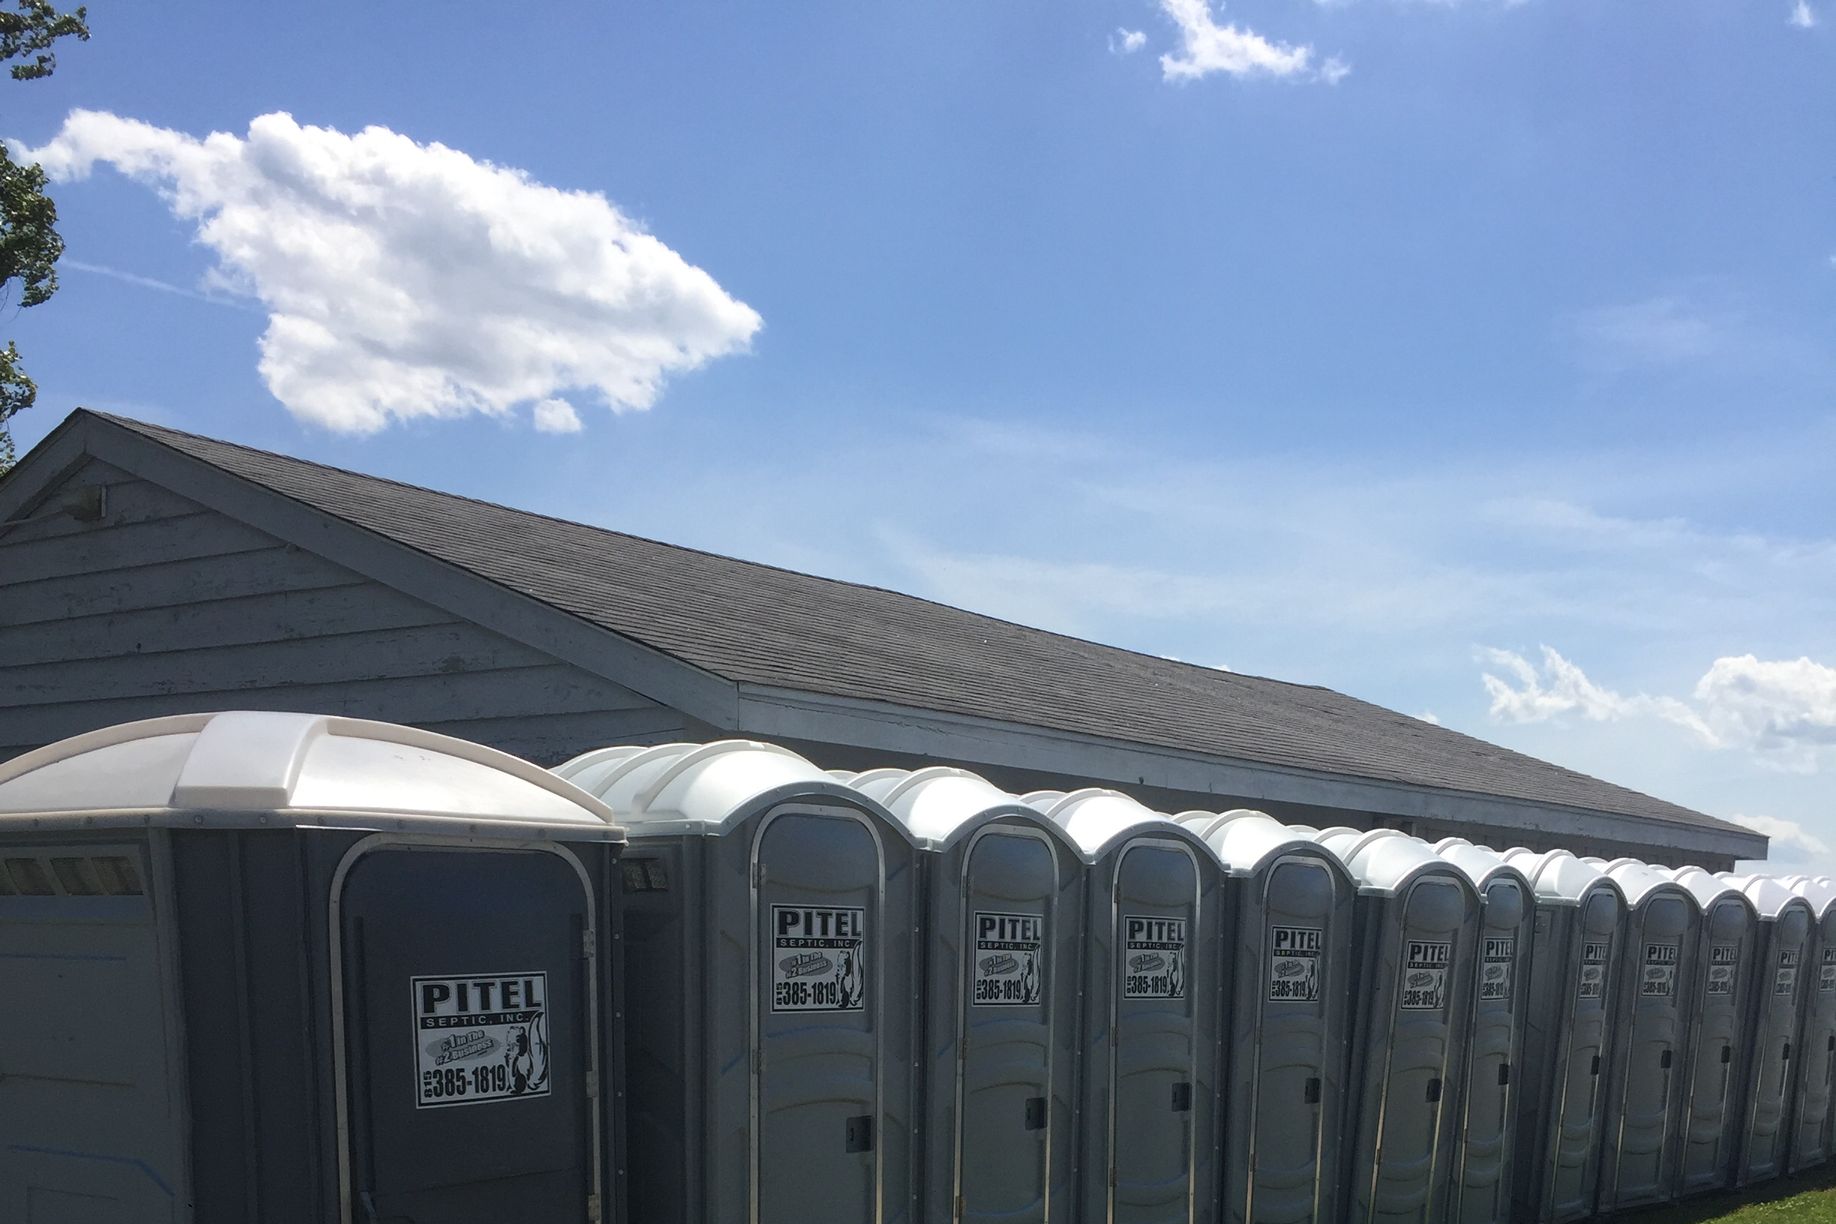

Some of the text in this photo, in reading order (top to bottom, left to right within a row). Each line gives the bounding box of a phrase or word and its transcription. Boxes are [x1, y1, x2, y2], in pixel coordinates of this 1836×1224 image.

[778, 910, 862, 937] PITEL
[979, 917, 1040, 941] PITEL
[1129, 920, 1184, 941] PITEL
[1275, 930, 1320, 950] PITEL
[1410, 945, 1449, 961] PITEL
[783, 981, 836, 1006] 385-1819
[982, 979, 1021, 1000] 385-1819
[1131, 975, 1168, 994] 385-1819
[422, 980, 542, 1014] PITEL
[500, 1013, 529, 1023] INC.
[467, 1030, 485, 1042] The
[451, 1039, 494, 1060] Business
[423, 1064, 507, 1098] 815 385-1819
